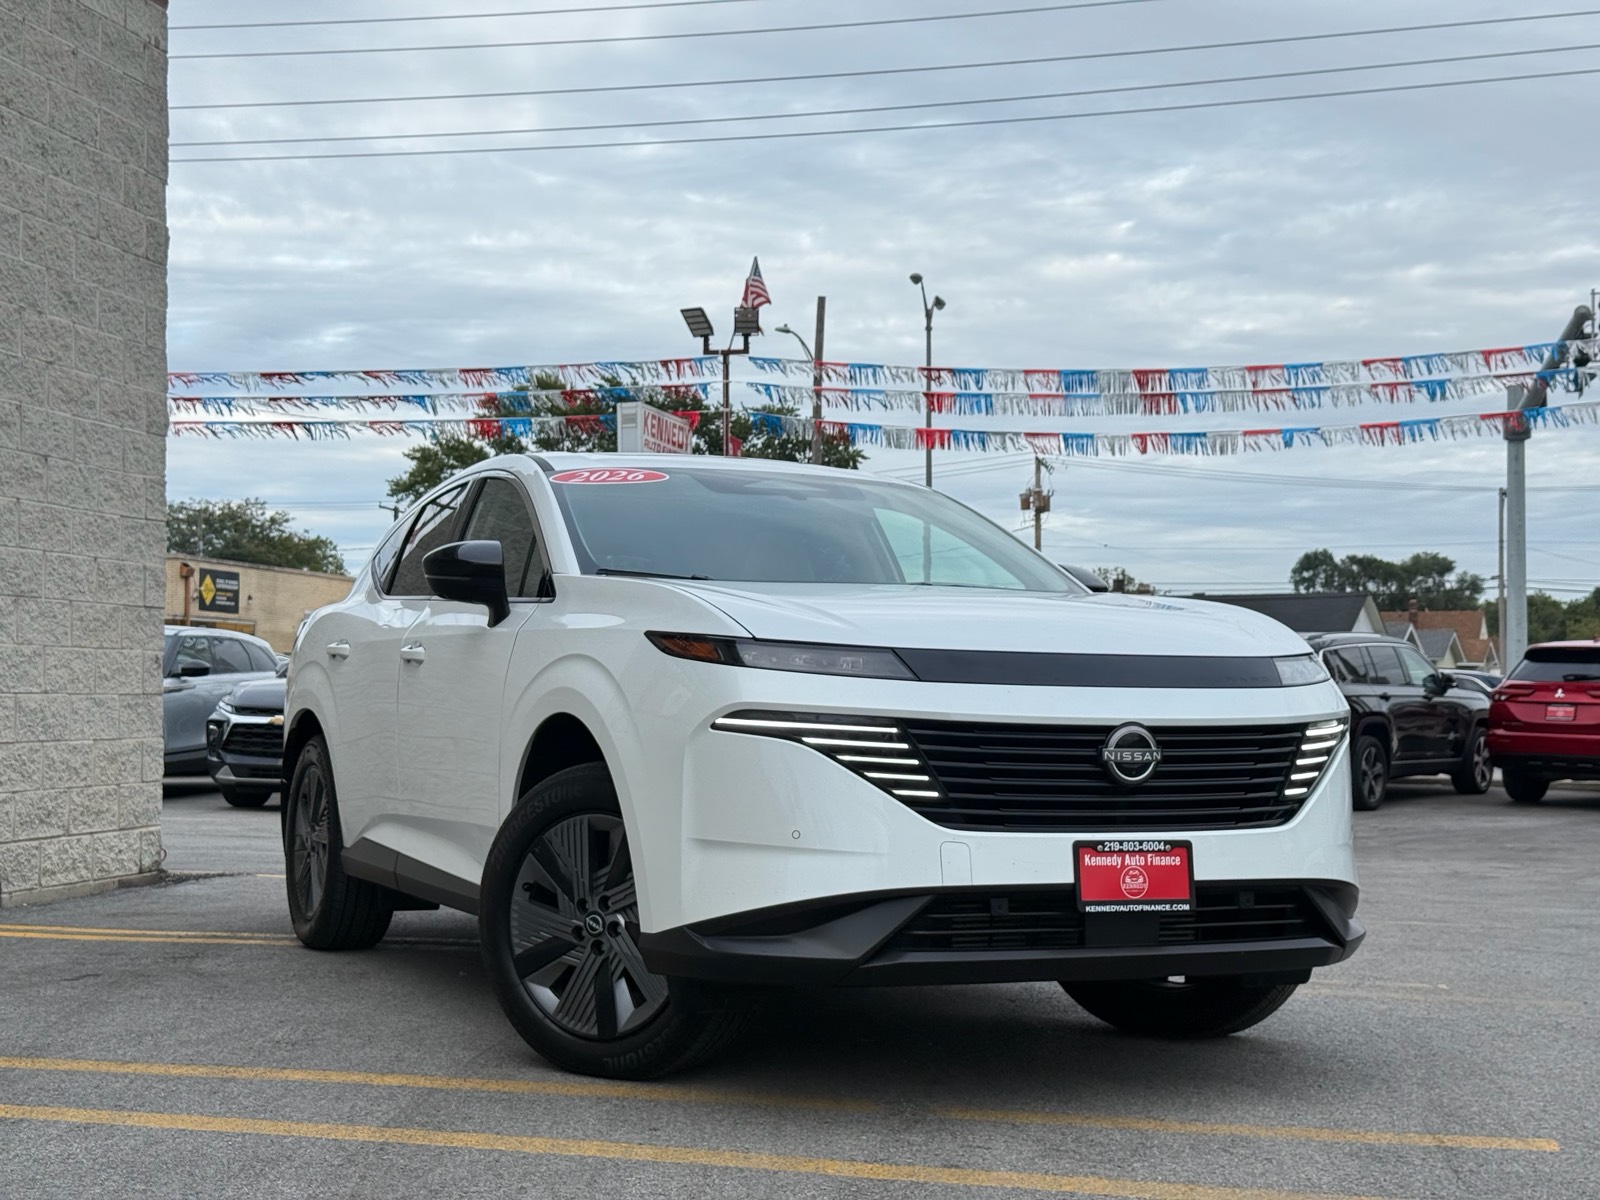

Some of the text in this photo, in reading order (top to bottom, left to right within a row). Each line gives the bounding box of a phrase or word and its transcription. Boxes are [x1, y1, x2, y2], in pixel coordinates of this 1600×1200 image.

[643, 410, 690, 452] KENNEDY
[644, 438, 661, 453] AUTO
[568, 470, 647, 482] 2026
[1104, 751, 1161, 761] NISSAN
[1104, 841, 1165, 851] 219-803-6004
[1084, 853, 1181, 868] Kennedy Auto Finance
[1085, 904, 1190, 912] KENNEDYAUTOFINANCE.COM
